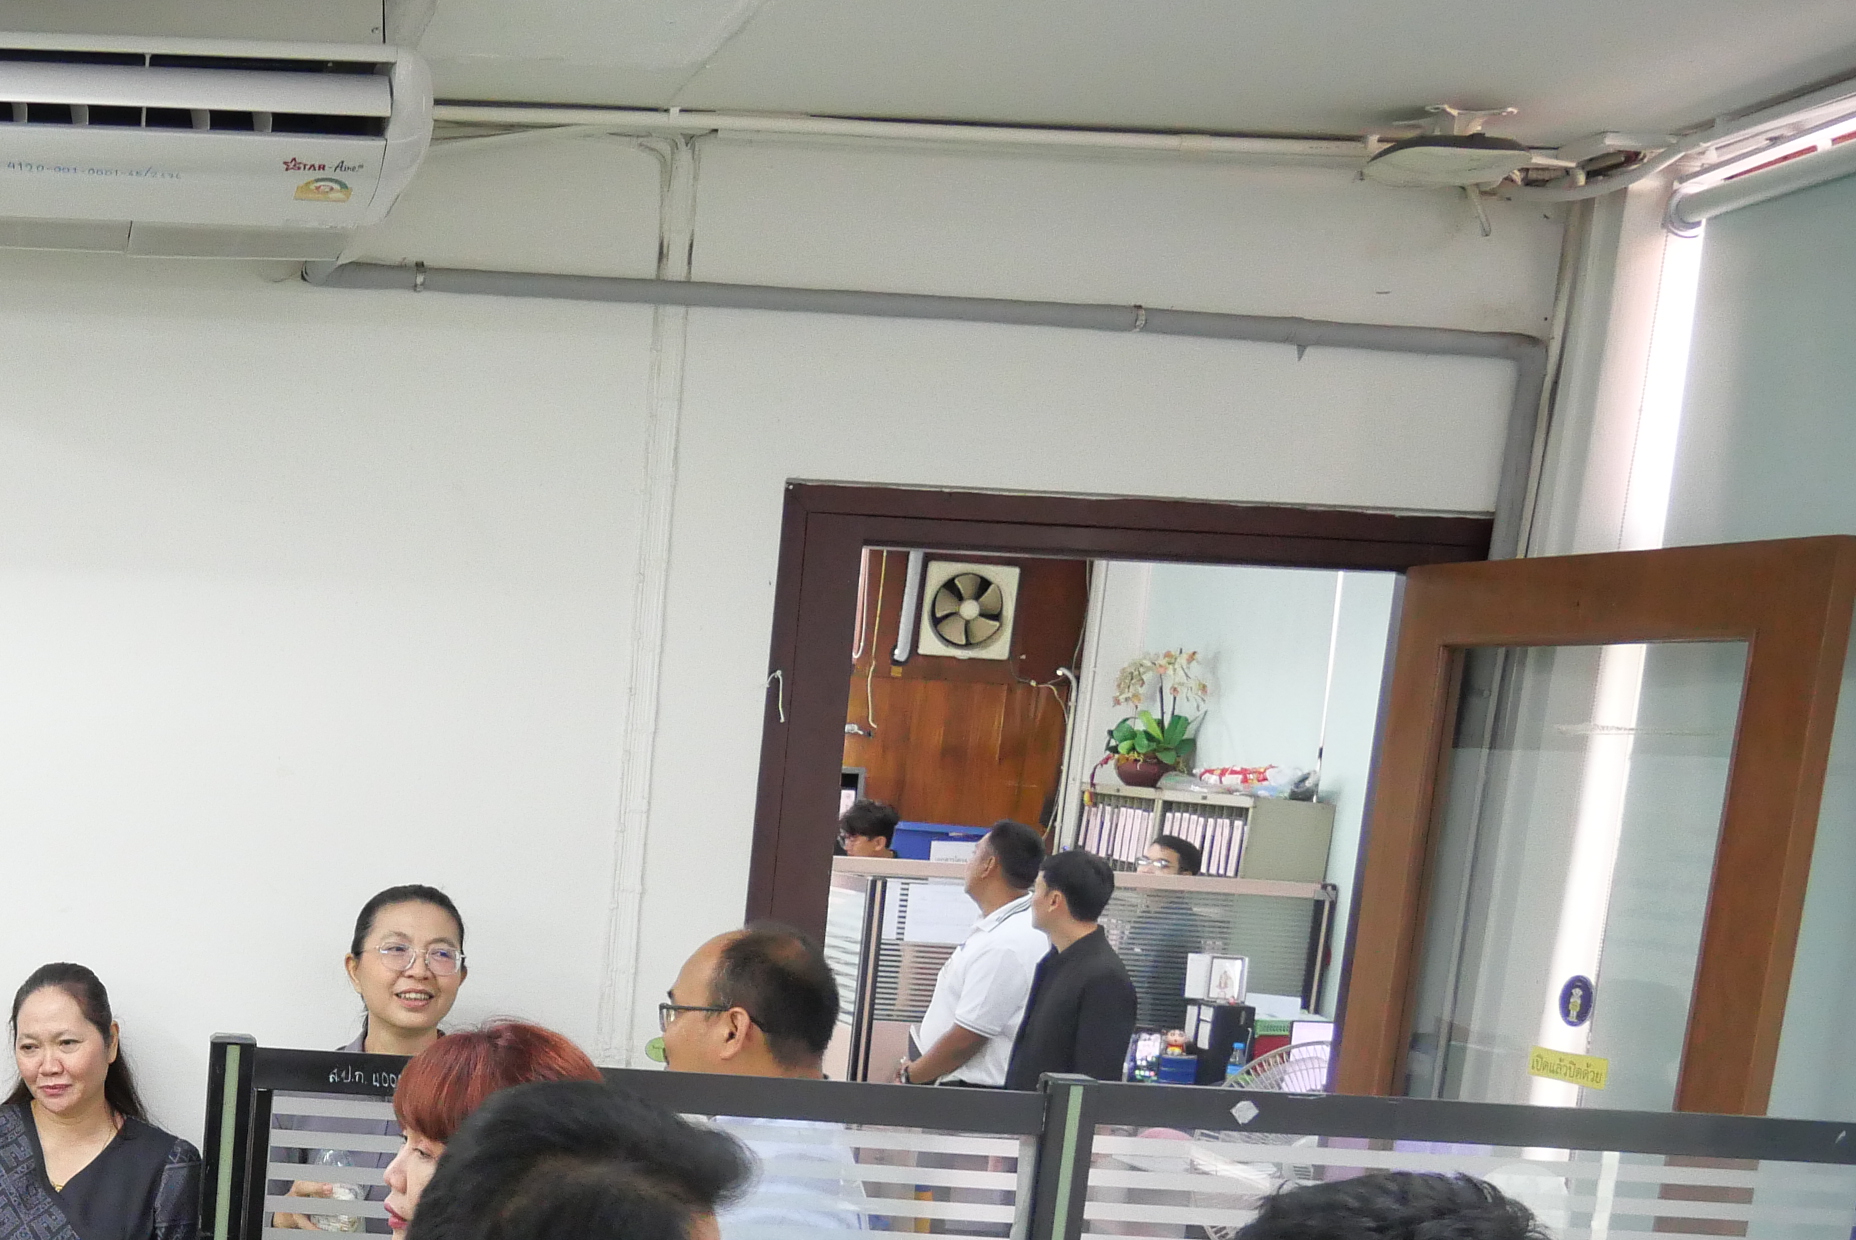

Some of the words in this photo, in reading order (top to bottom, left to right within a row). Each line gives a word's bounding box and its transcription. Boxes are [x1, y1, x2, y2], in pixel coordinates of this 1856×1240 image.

[372, 1071, 403, 1089] 400
[1531, 1054, 1603, 1084] เปิดแล้วปิดด้วย
